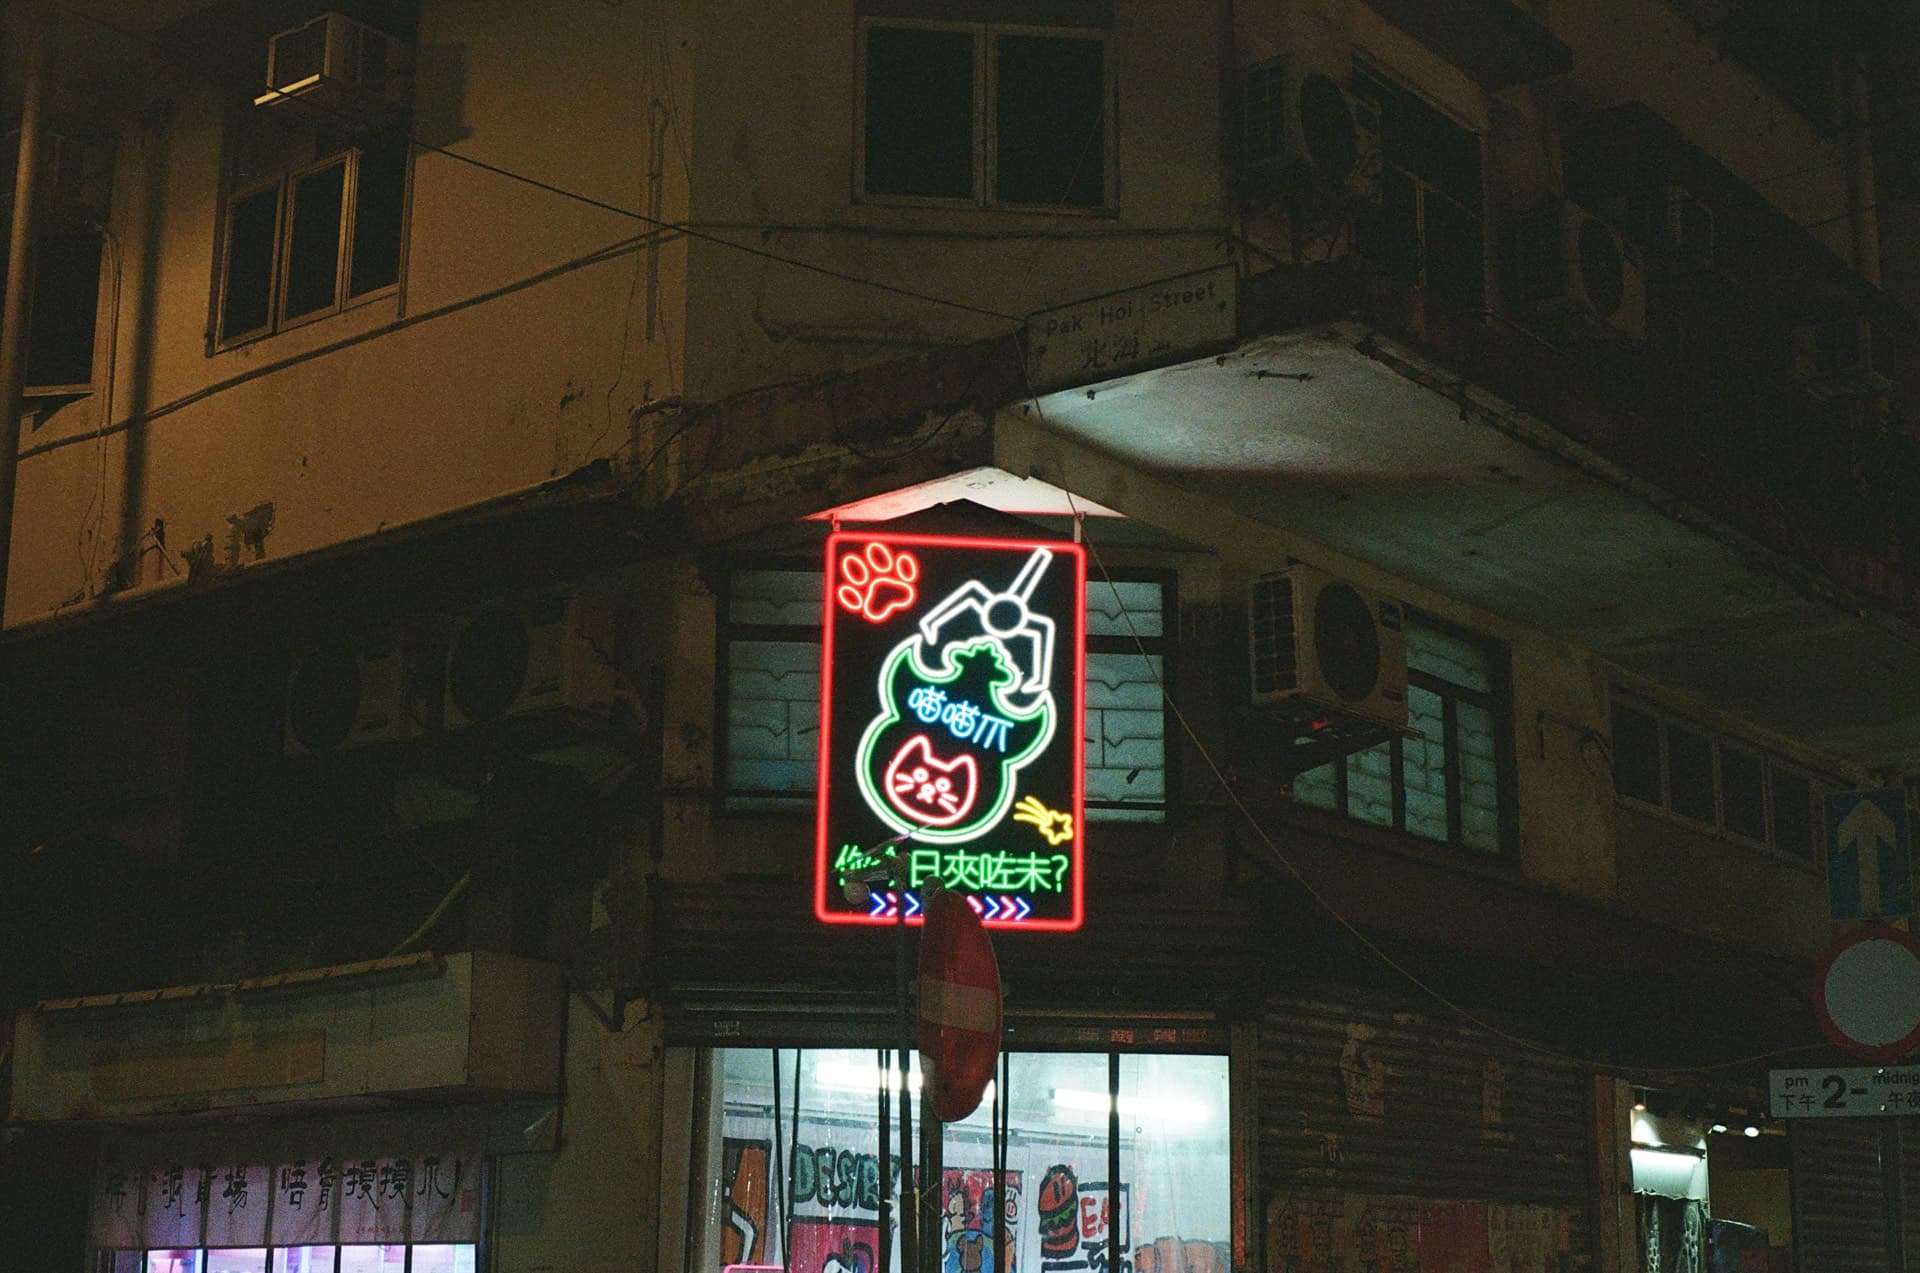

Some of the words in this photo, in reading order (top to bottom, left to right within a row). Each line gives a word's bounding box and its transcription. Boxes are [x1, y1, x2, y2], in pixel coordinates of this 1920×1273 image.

[1046, 315, 1083, 337] Pak
[1151, 281, 1216, 313] Street
[907, 684, 1015, 752] 喵喵爪
[1785, 1077, 1809, 1089] pm
[1779, 1093, 1816, 1111] 下午
